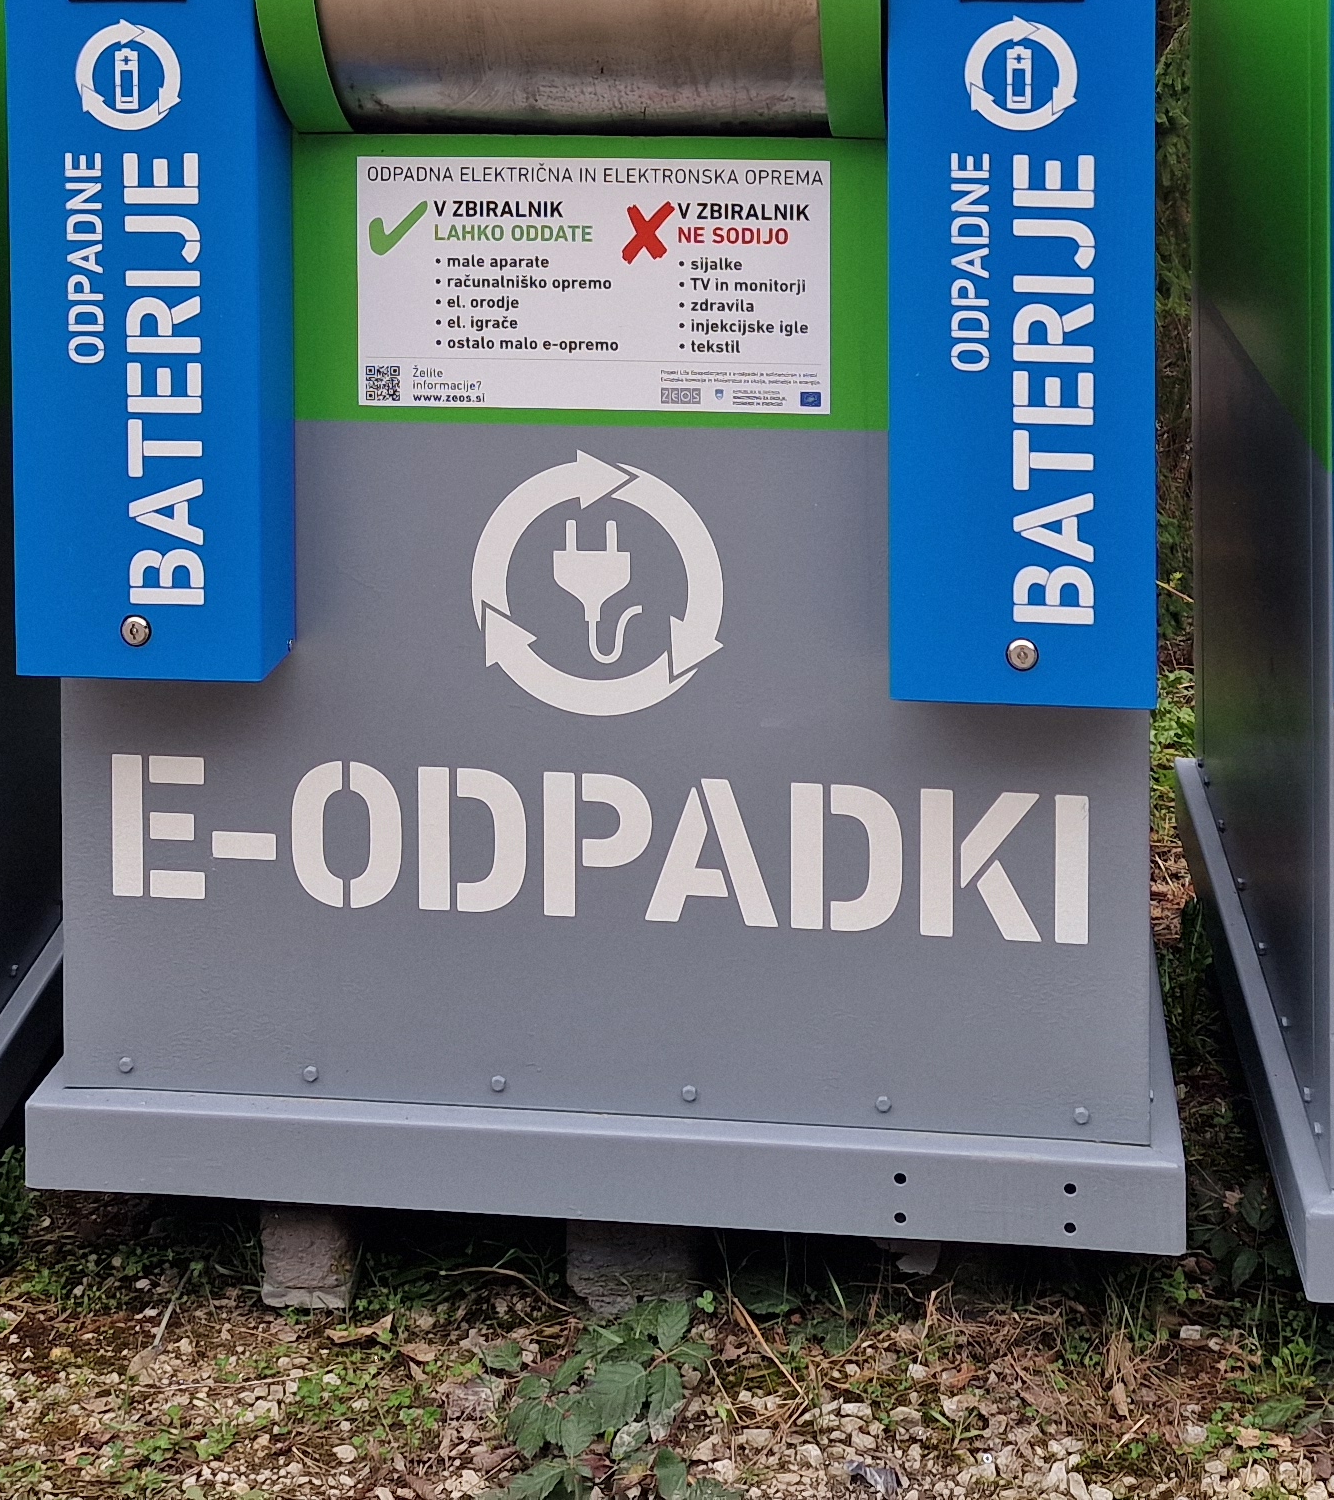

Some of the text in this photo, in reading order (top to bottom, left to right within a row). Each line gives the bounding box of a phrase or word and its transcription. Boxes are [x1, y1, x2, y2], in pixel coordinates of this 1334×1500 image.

[367, 162, 824, 186] ODPADNA ELEKTRIČNA IN ELEKTRONSKA OPREMA
[433, 200, 564, 218] V ZBIRALNIK
[677, 202, 810, 222] V ZBIRALNIK
[434, 223, 593, 243] LAHKO ODDATE
[677, 226, 789, 245] NE SODIJO
[64, 152, 105, 364] ODPADNE
[446, 254, 550, 272] male aparate
[690, 256, 743, 274] sijalke
[950, 152, 990, 372] ODPADNE
[447, 274, 612, 293] računalniško opremo
[689, 277, 806, 296] TV in monitorji
[446, 294, 520, 312] el. orodje
[690, 298, 755, 313] zdravila
[447, 315, 519, 332] el. igrače
[691, 318, 809, 337] injekcijske igle
[447, 335, 619, 354] ostalo malo e-opremo
[690, 339, 741, 354] tekstil
[122, 152, 205, 606] BATERIJE
[412, 364, 444, 378] Želite
[412, 379, 482, 393] informacije?
[1012, 154, 1096, 625] BATERIJE
[412, 392, 485, 403] www.zeos.si
[111, 753, 1090, 945] E-ODPADKI
